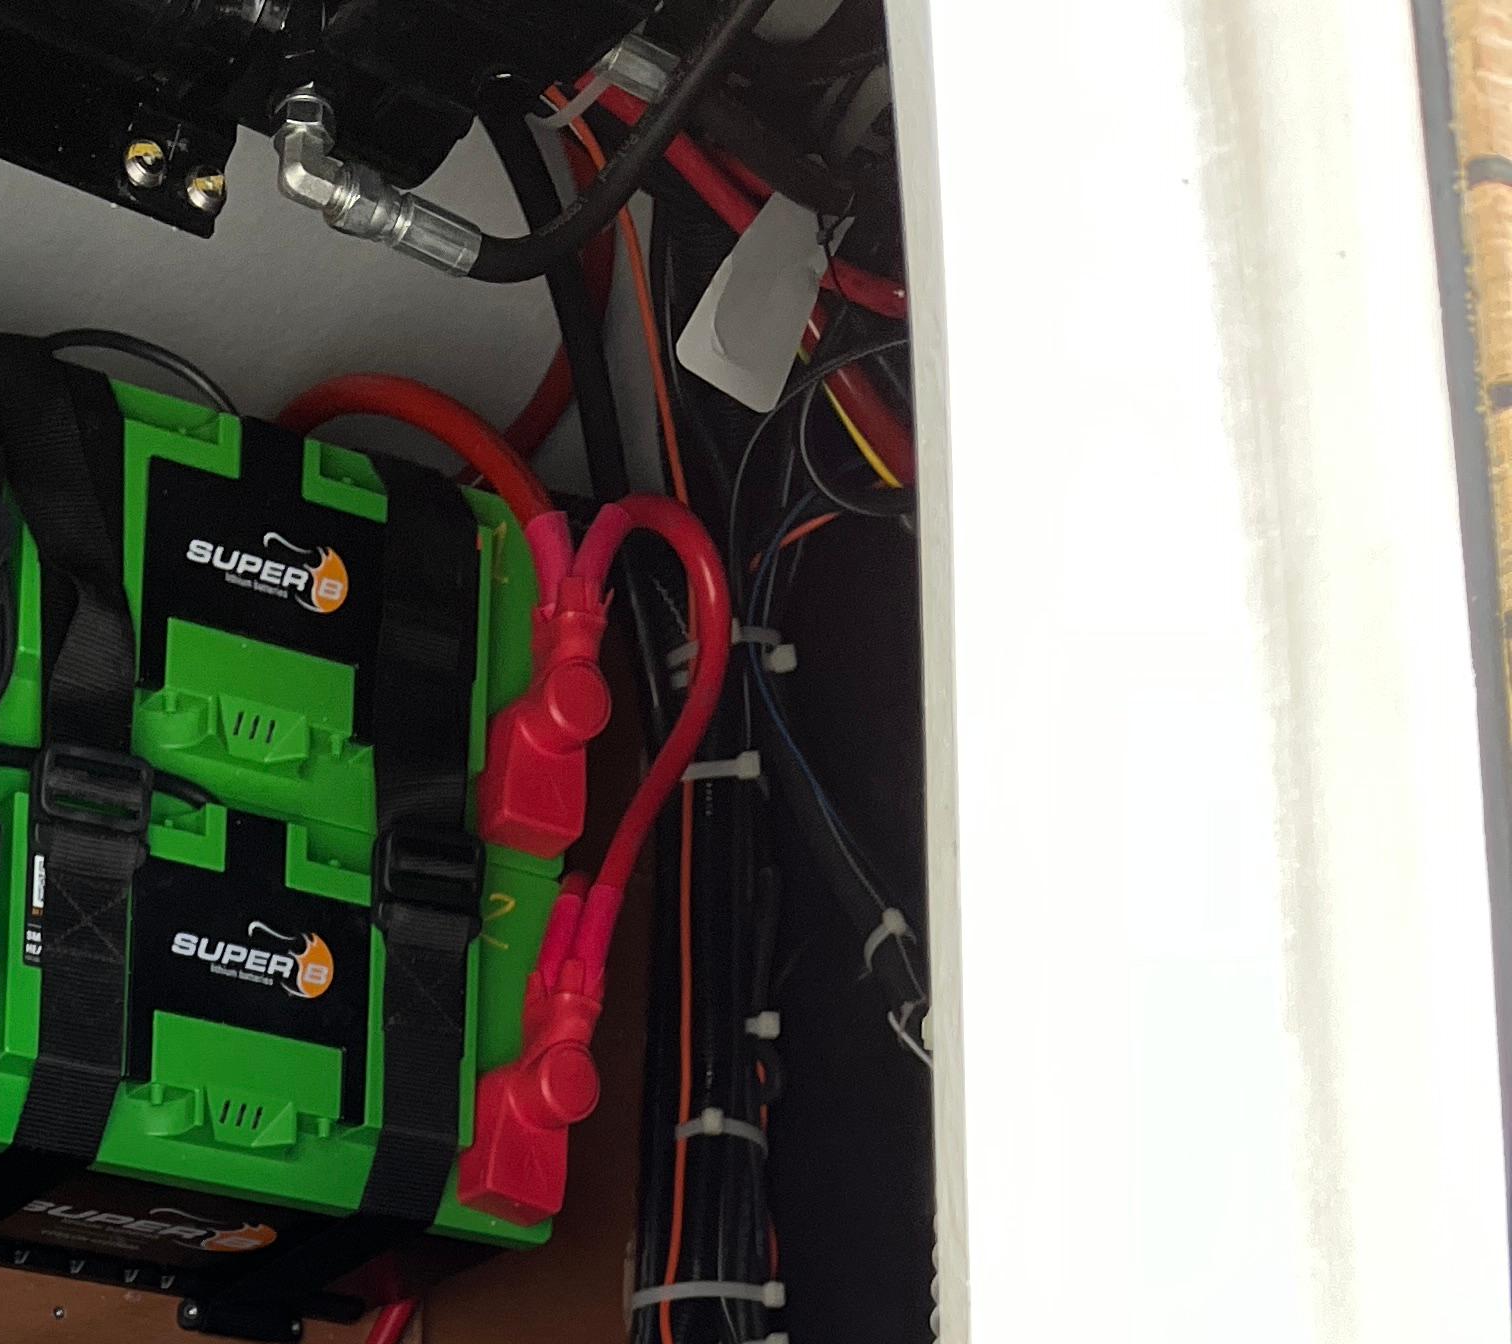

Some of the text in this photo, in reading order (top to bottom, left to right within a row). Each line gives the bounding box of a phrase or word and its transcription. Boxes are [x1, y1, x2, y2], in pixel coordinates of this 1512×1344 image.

[184, 537, 343, 601] SUPER B
[169, 930, 329, 985] SUPER B
